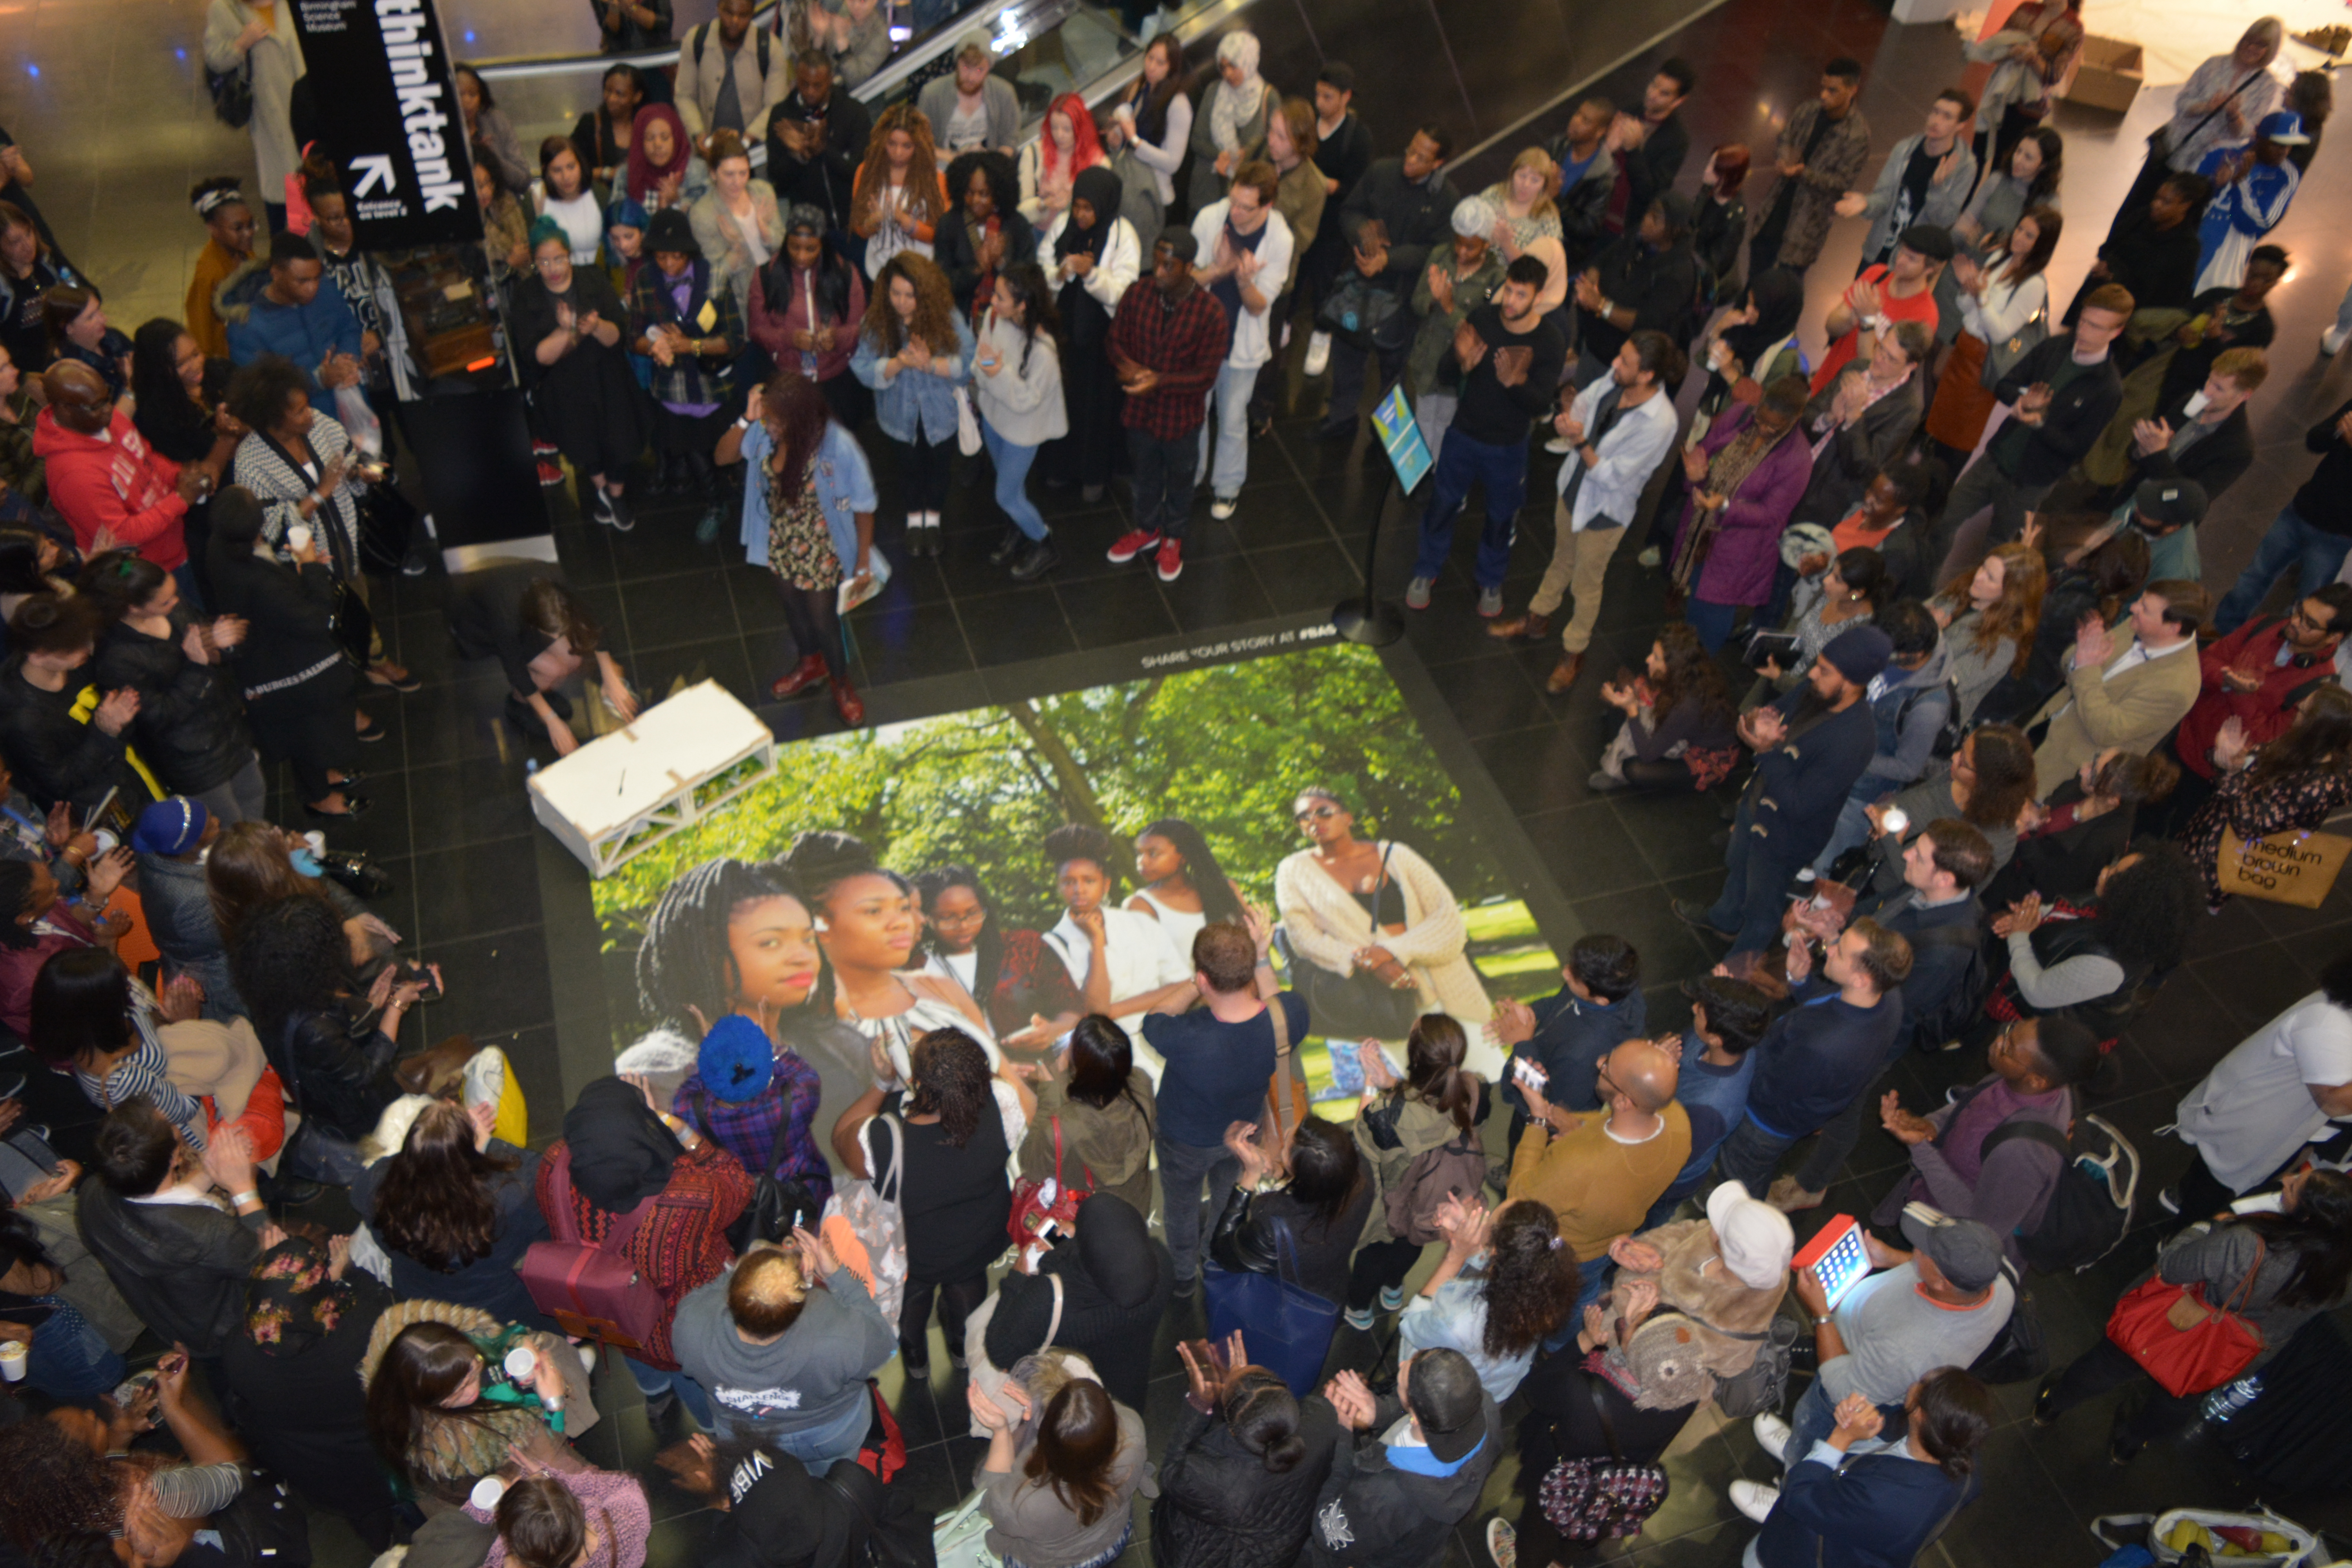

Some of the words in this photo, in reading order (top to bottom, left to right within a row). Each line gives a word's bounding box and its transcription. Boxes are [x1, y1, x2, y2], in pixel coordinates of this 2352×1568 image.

[300, 1, 357, 11] Birmingham
[303, 11, 341, 21] Science
[306, 21, 348, 32] Museum
[375, 0, 465, 214] thinktank
[356, 200, 402, 212] Entrance
[359, 212, 372, 221] on
[374, 208, 398, 219] level
[1142, 649, 1190, 669] SHARE
[1190, 643, 1229, 658] YOUR
[1230, 633, 1275, 652] STORY
[1279, 630, 1294, 644] AT
[256, 675, 299, 694] BURGES
[299, 651, 342, 681] SALMON
[2245, 838, 2322, 865] medium
[2243, 852, 2300, 876] brown
[2239, 866, 2276, 890] bag
